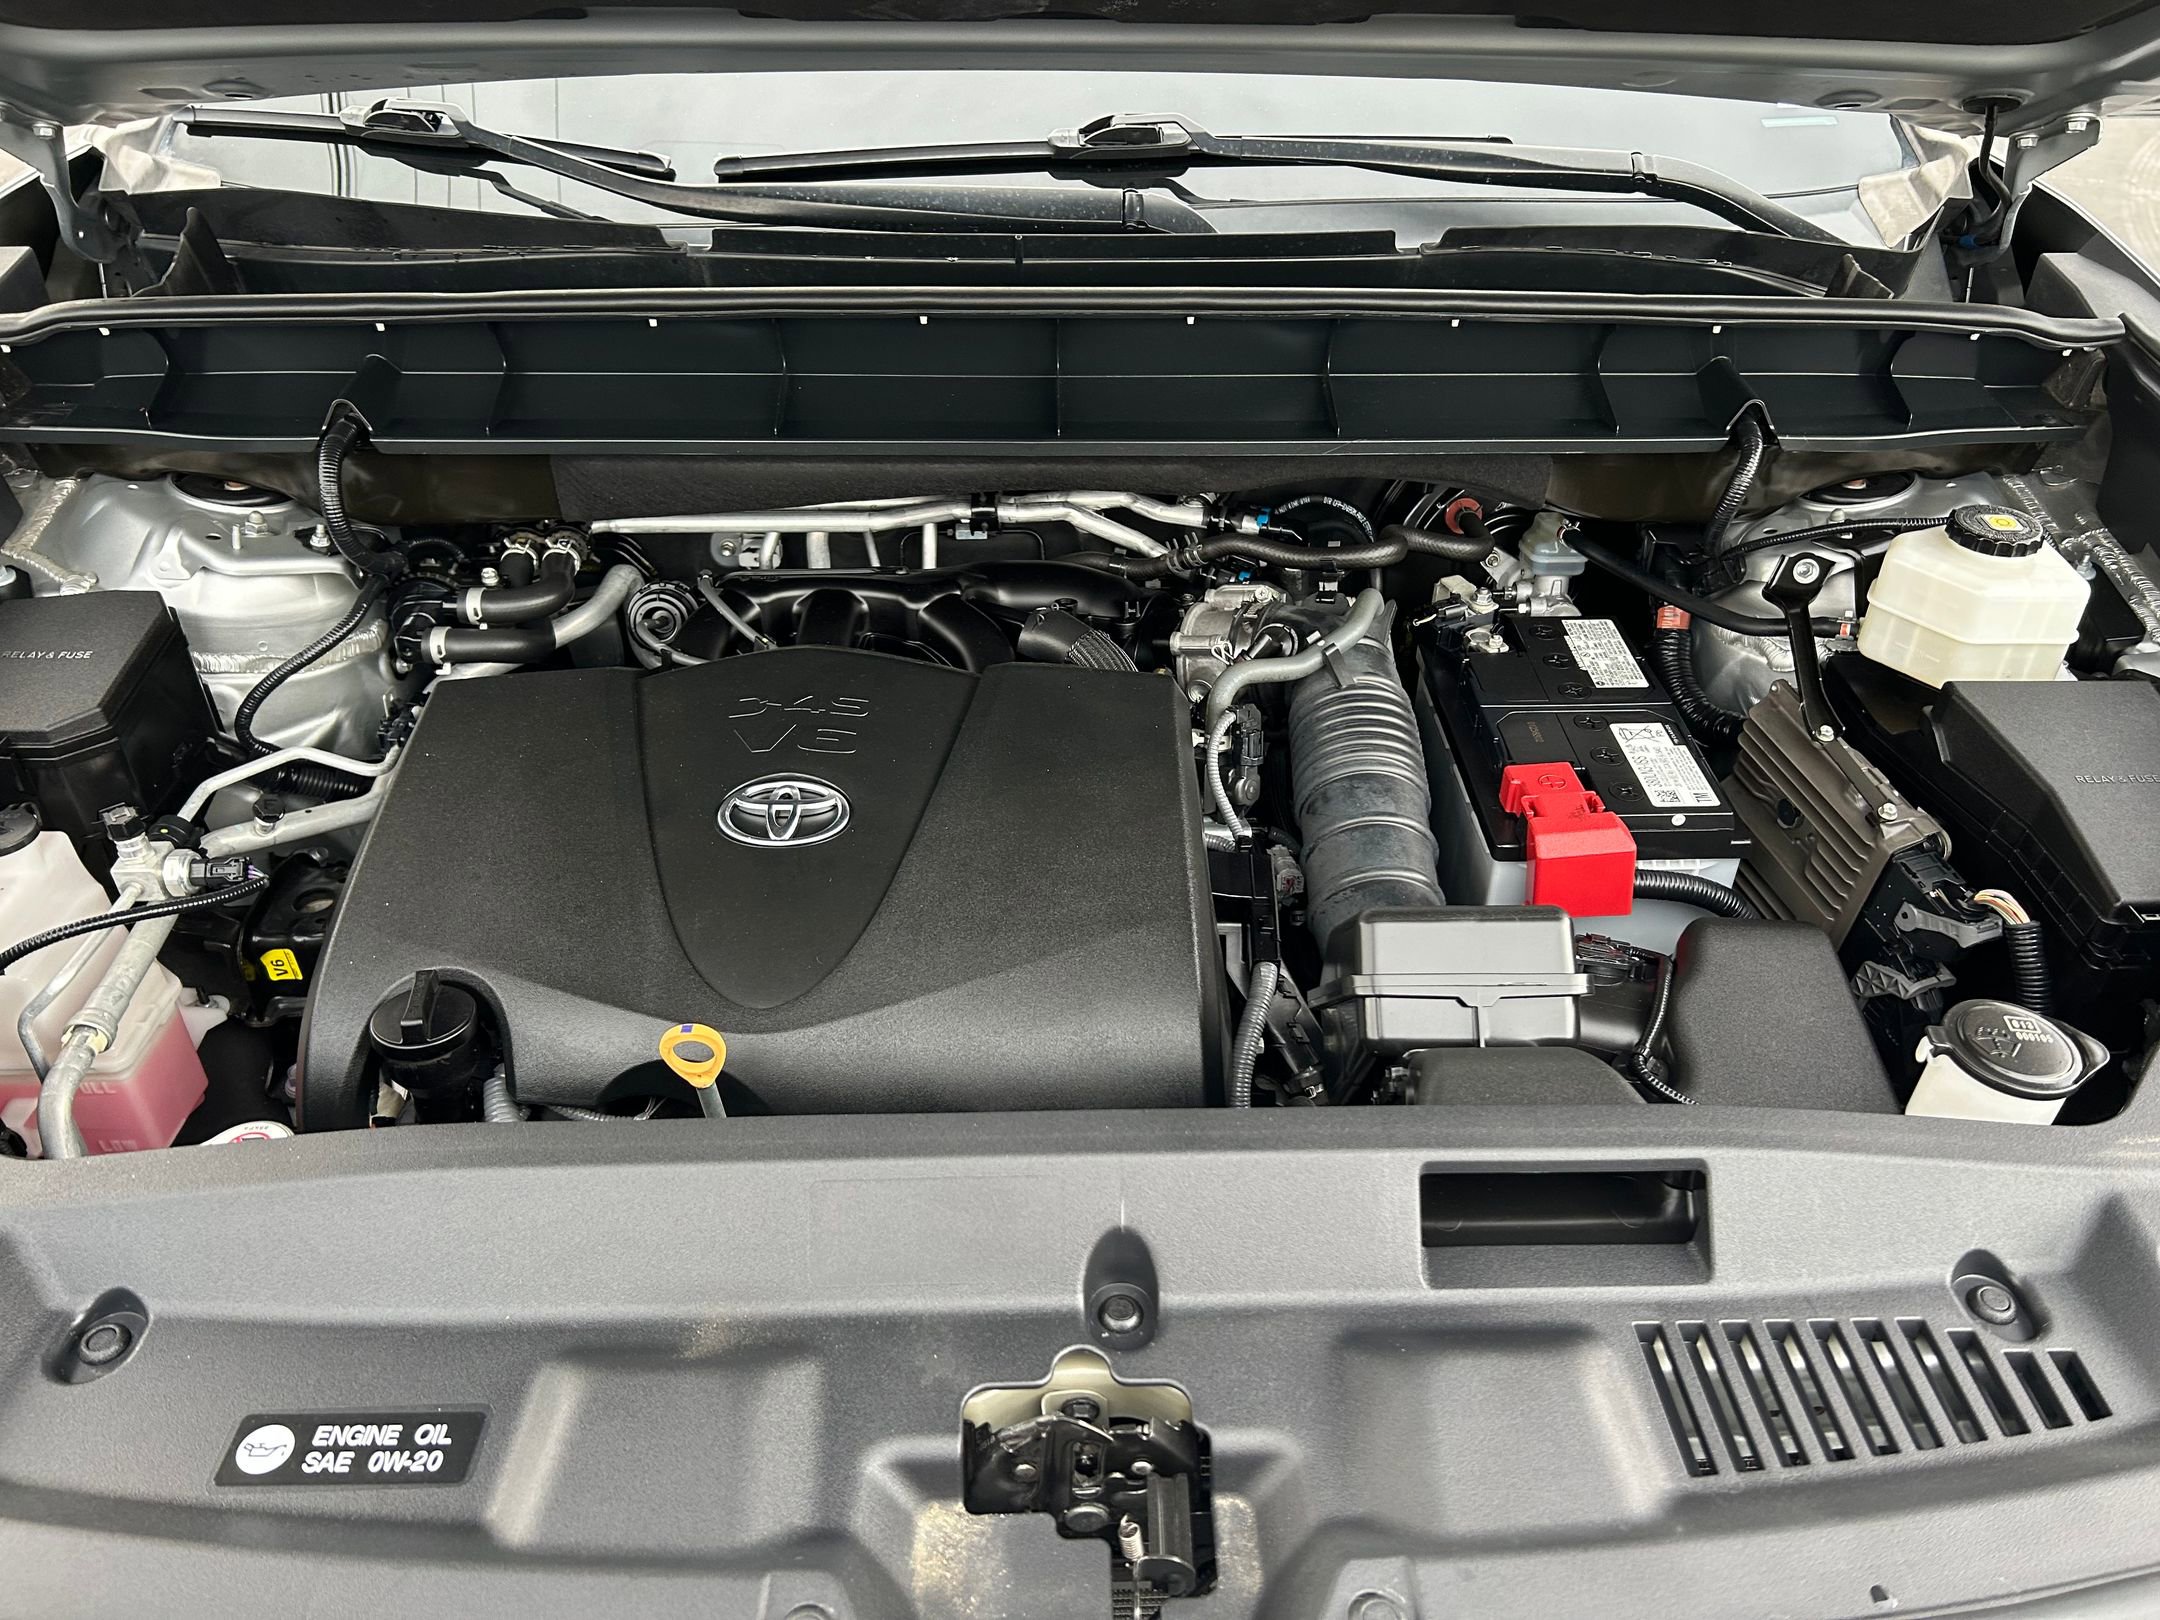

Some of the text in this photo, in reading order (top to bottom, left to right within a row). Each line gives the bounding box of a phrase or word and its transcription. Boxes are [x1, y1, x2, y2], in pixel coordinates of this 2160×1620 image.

[2, 651, 46, 659] RELAY
[57, 650, 94, 659] FUSE
[2075, 775, 2114, 783] RELAY
[2128, 774, 2160, 783] FUSE
[271, 960, 288, 976] V6
[79, 1082, 117, 1094] ULL
[311, 1424, 452, 1446] ENGINE OIL
[301, 1450, 444, 1473] SAE 0W-20
